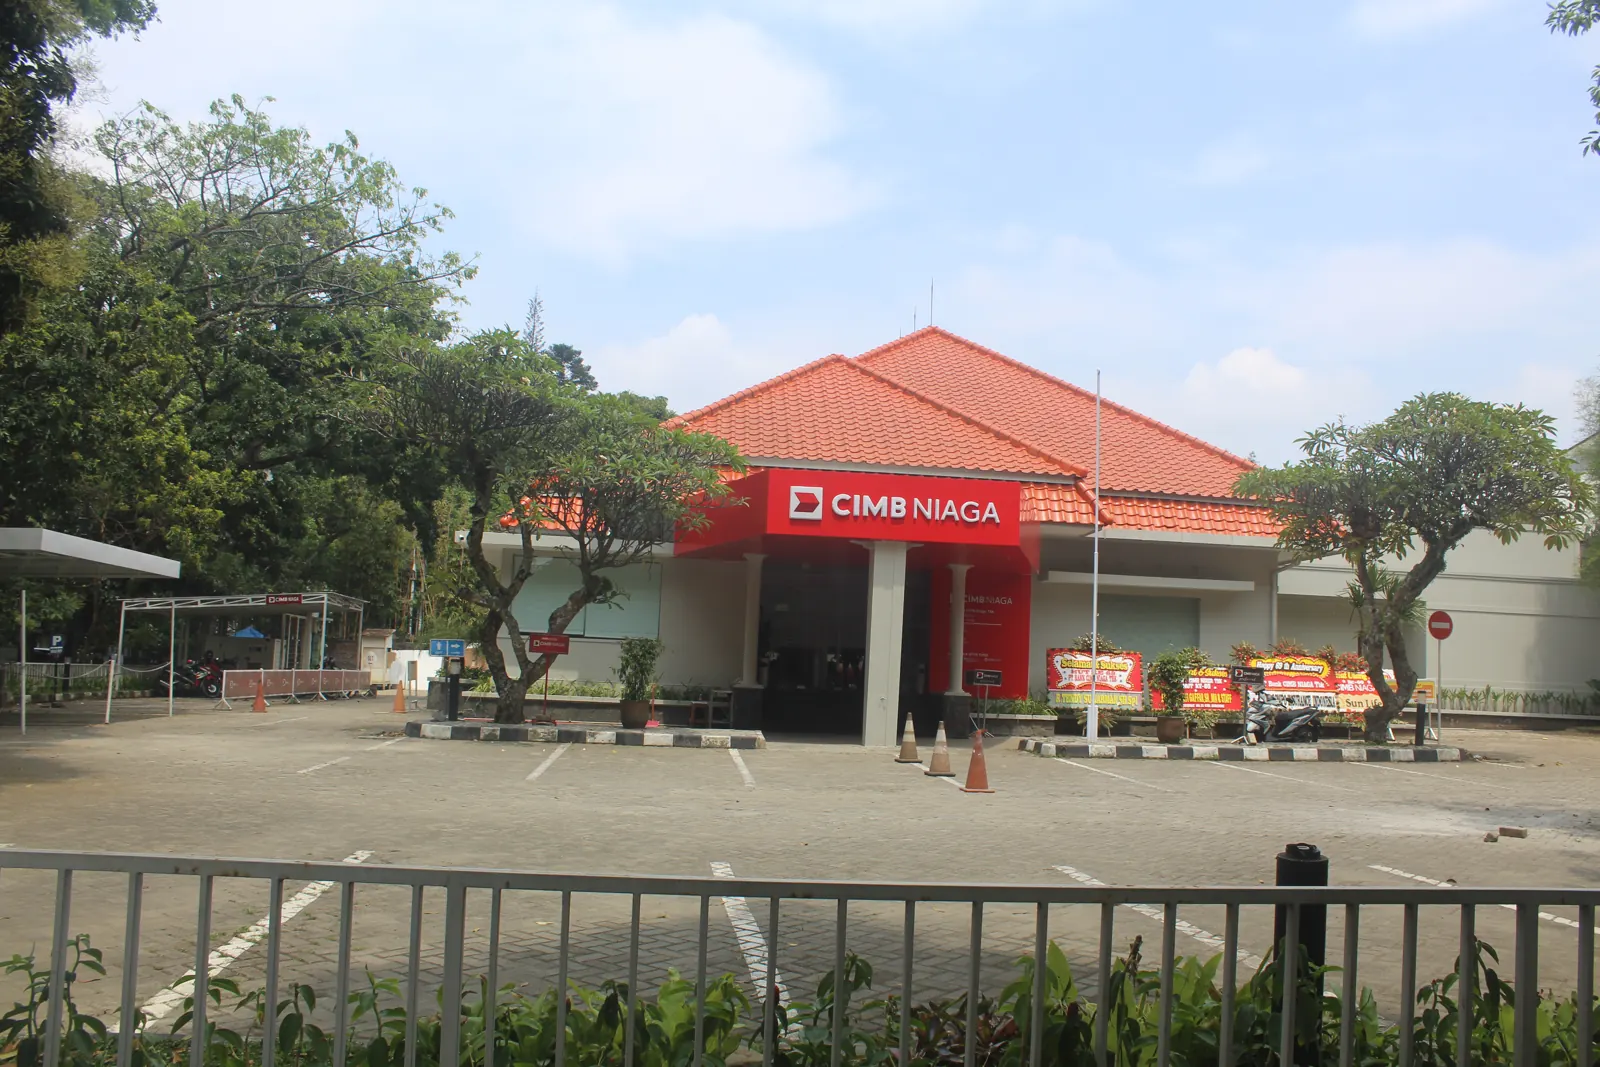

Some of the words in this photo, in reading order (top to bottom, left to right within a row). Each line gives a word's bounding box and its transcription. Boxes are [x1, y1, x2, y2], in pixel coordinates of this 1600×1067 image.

[831, 493, 907, 519] CIMB
[913, 497, 1000, 524] NIAGA
[986, 596, 1013, 605] NIAGA
[52, 635, 62, 646] P
[1061, 658, 1095, 669] Selama
[1101, 660, 1128, 671] Sukses
[1256, 660, 1275, 671] Happy
[1290, 662, 1324, 674] Anniversary
[1283, 680, 1297, 688] CIMB
[1298, 680, 1314, 688] NIAGA
[1355, 684, 1376, 692] NIAG
[1345, 698, 1363, 708] Sun
[1365, 698, 1382, 709] Life
